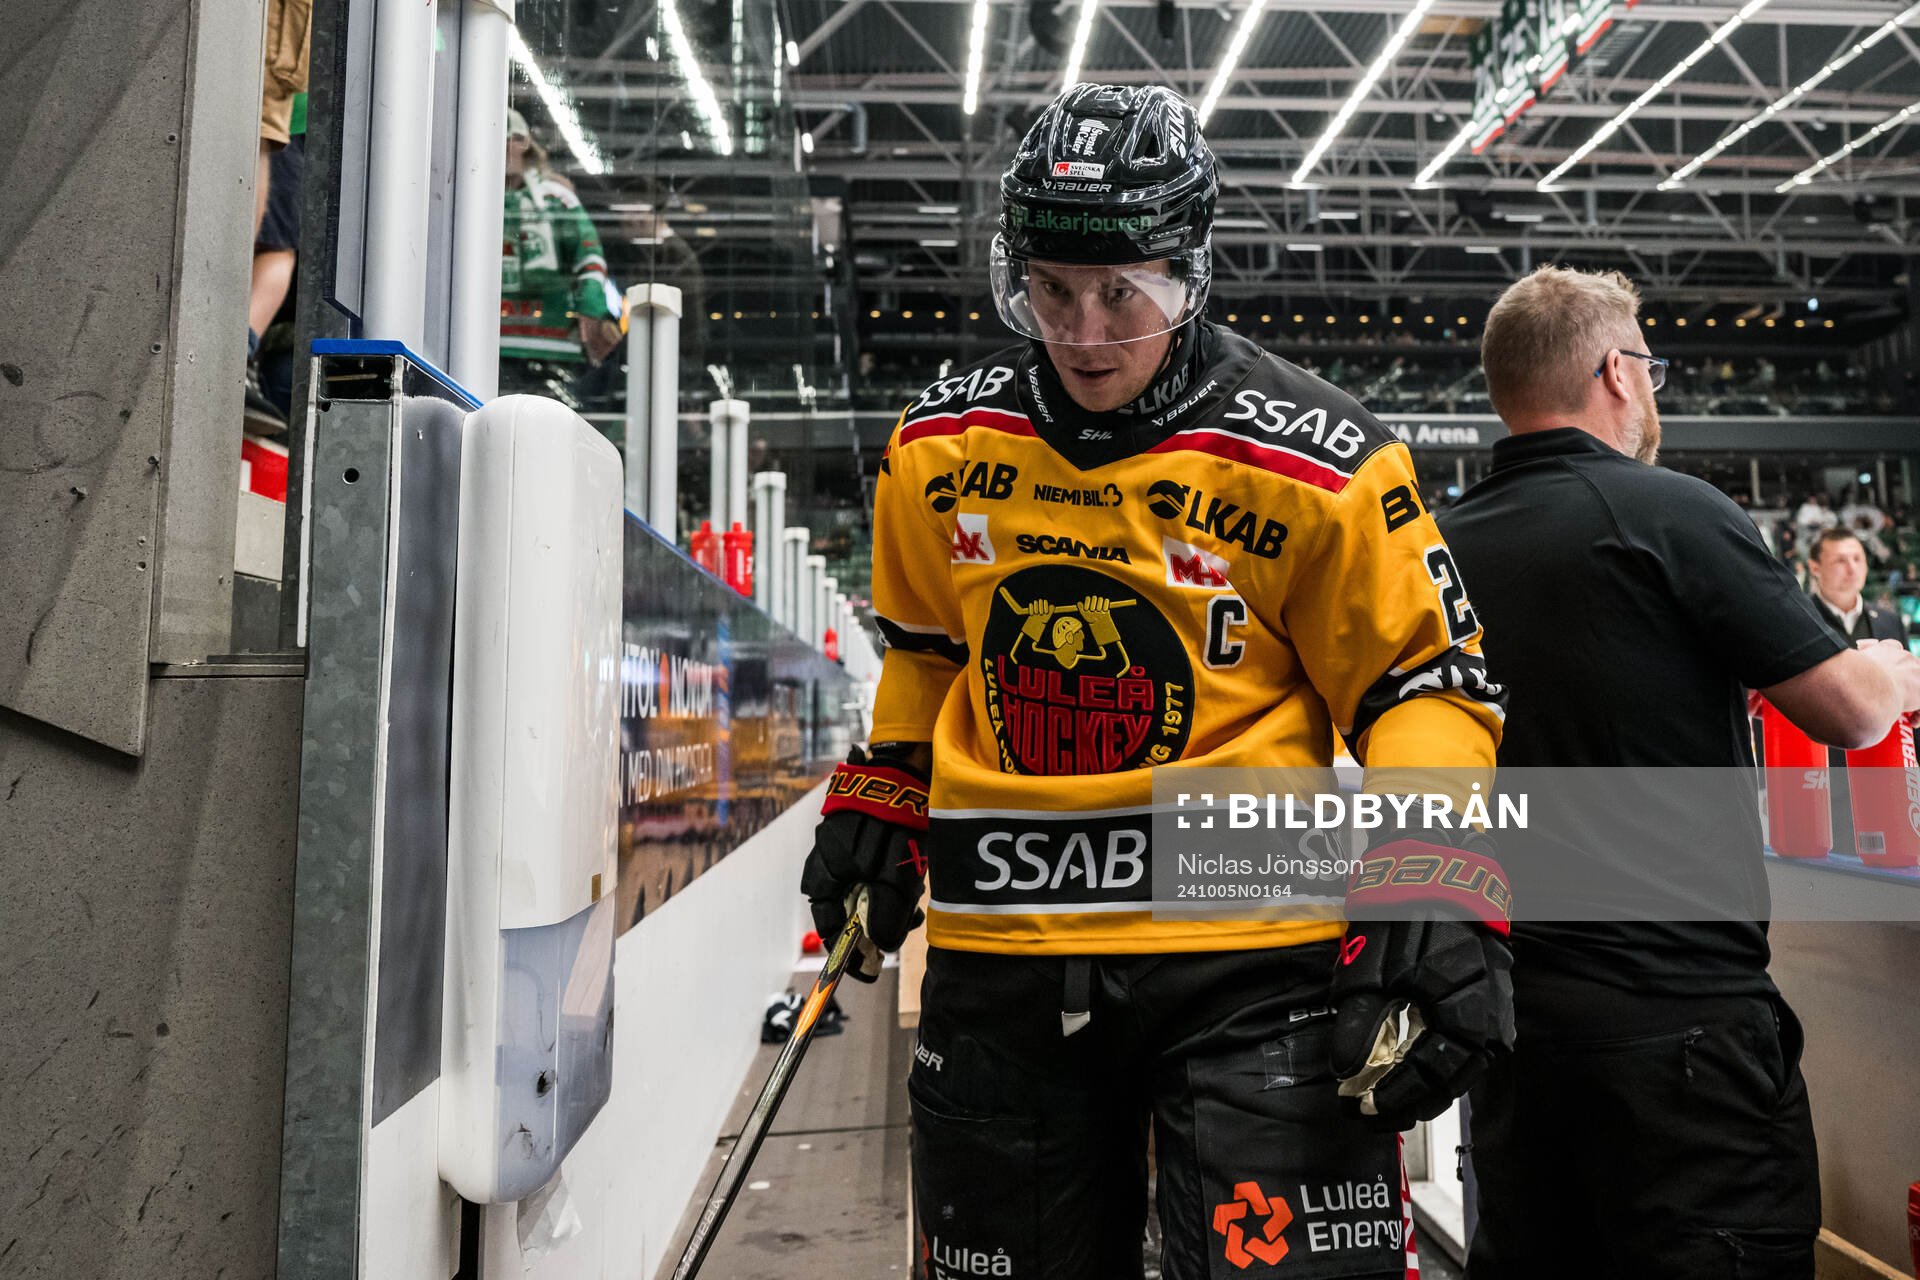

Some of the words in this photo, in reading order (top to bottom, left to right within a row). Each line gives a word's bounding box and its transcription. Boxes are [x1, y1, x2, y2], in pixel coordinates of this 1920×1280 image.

[907, 366, 1014, 415] SSAB
[1138, 363, 1189, 414] LKAB
[1223, 389, 1366, 459] SSAB
[1416, 423, 1480, 444] Arena
[959, 460, 1018, 500] AB
[1015, 533, 1132, 566] SCANIA
[1185, 490, 1289, 560] LKAB
[1170, 553, 1227, 587] MA
[1203, 595, 1249, 670] C
[997, 654, 1155, 712] LULEÅ
[1161, 681, 1184, 737] 1977
[1001, 693, 1153, 776] HOCKEY
[1802, 770, 1829, 790] SH
[974, 829, 1148, 892] SSAB
[1350, 855, 1513, 926] BAUE
[1300, 1174, 1391, 1214] Luleå
[933, 1235, 1012, 1277] Luleå
[1306, 1219, 1403, 1253] Energ
